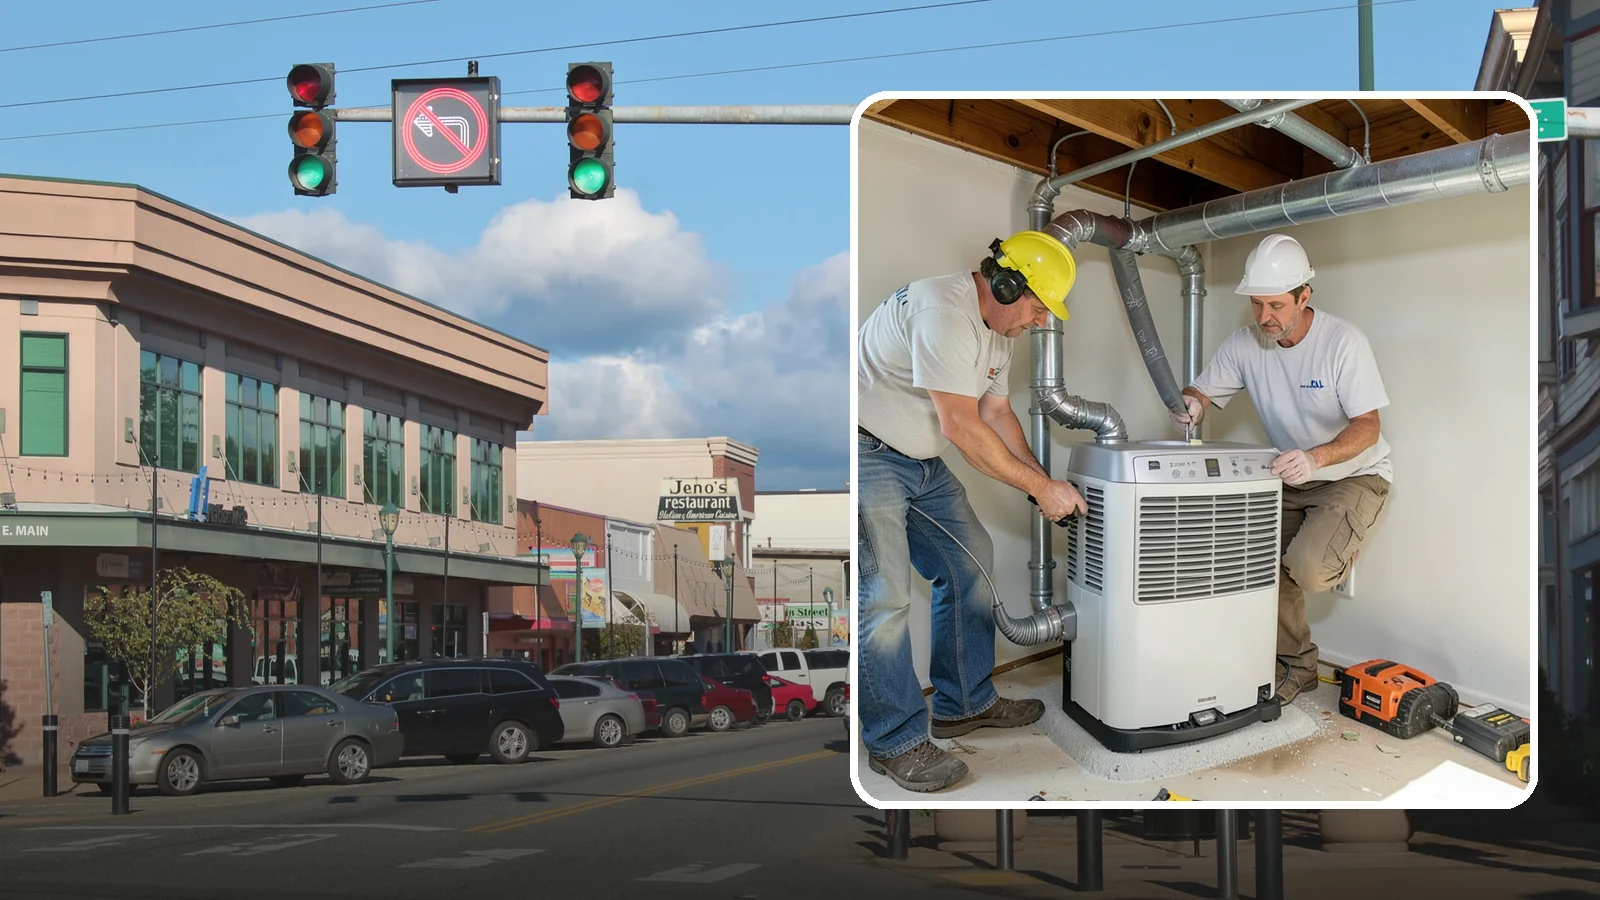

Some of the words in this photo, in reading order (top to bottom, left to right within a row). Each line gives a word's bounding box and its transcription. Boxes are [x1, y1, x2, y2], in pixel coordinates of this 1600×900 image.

[669, 480, 727, 495] Jeno's
[665, 496, 731, 509] restaurant
[686, 509, 715, 519] American
[715, 509, 738, 519] Cuisine
[2, 525, 13, 536] E.
[15, 525, 49, 536] MAIN
[797, 607, 828, 617] Street
[791, 619, 824, 627] lass
